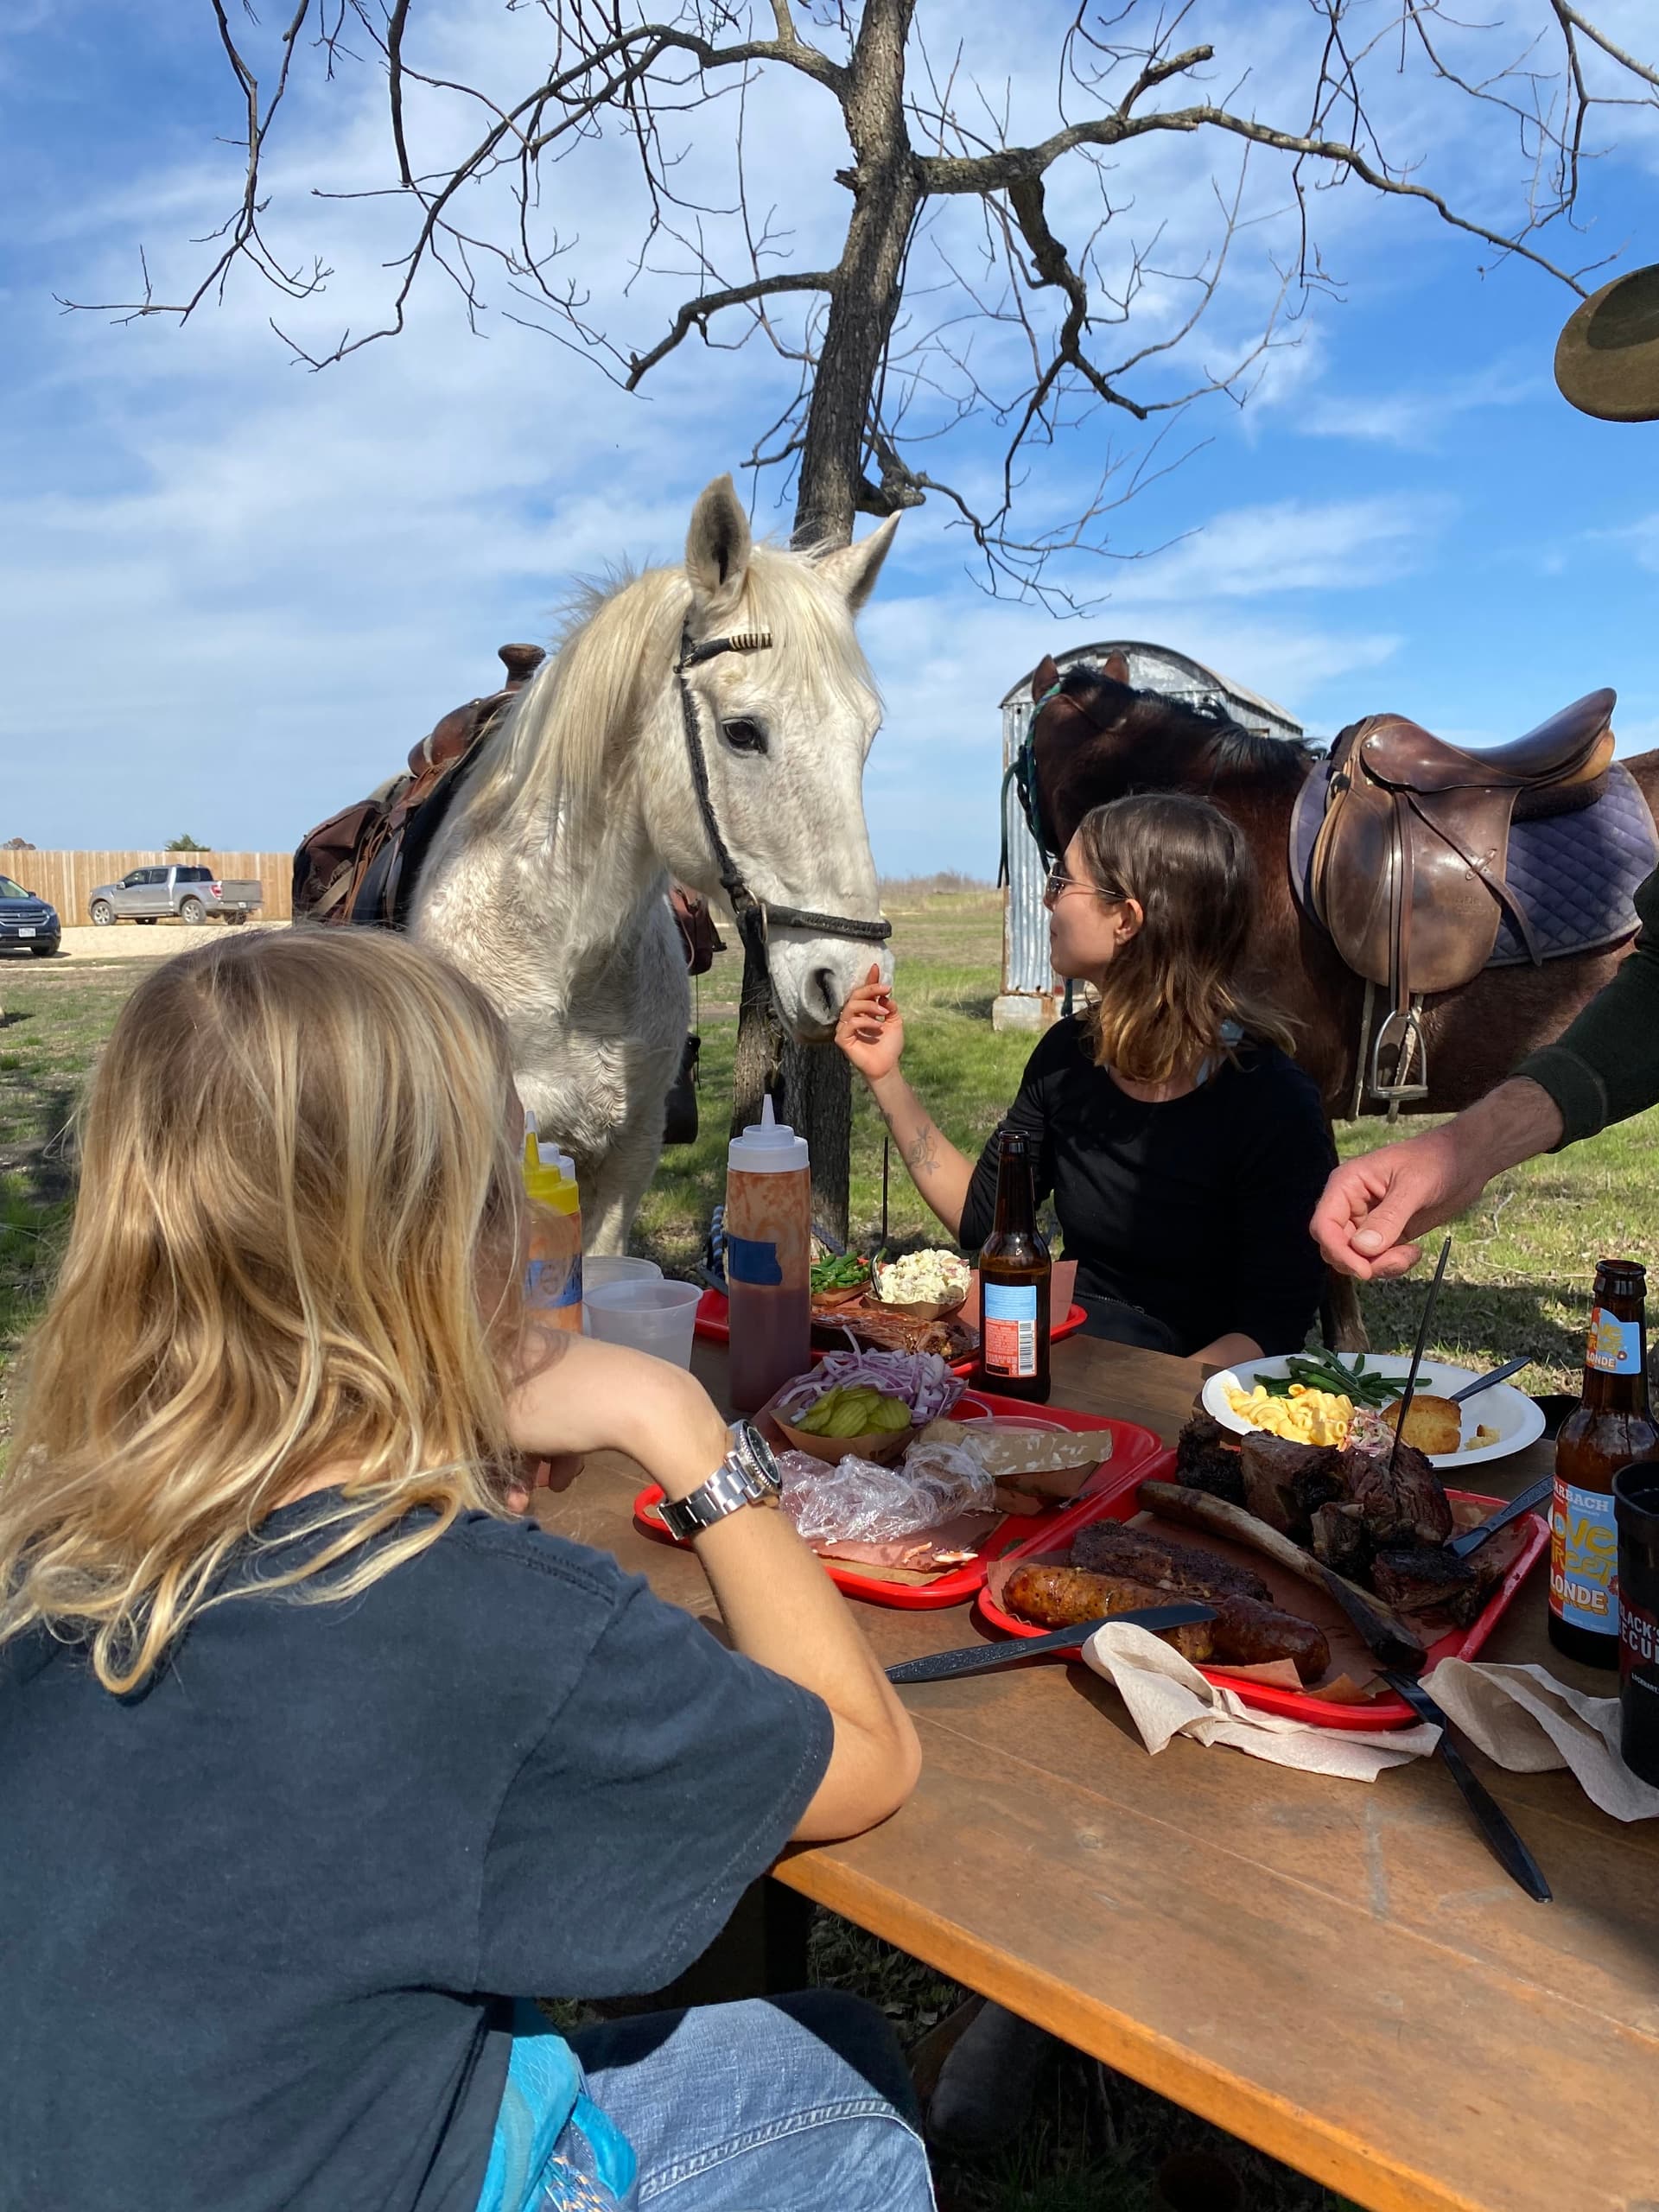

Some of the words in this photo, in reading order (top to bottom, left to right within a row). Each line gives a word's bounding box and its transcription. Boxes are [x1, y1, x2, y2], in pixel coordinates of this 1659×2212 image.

[1586, 1350, 1616, 1369] LONDE
[1554, 1480, 1609, 1512] ARBACH
[1550, 1566, 1608, 1614] LONDE
